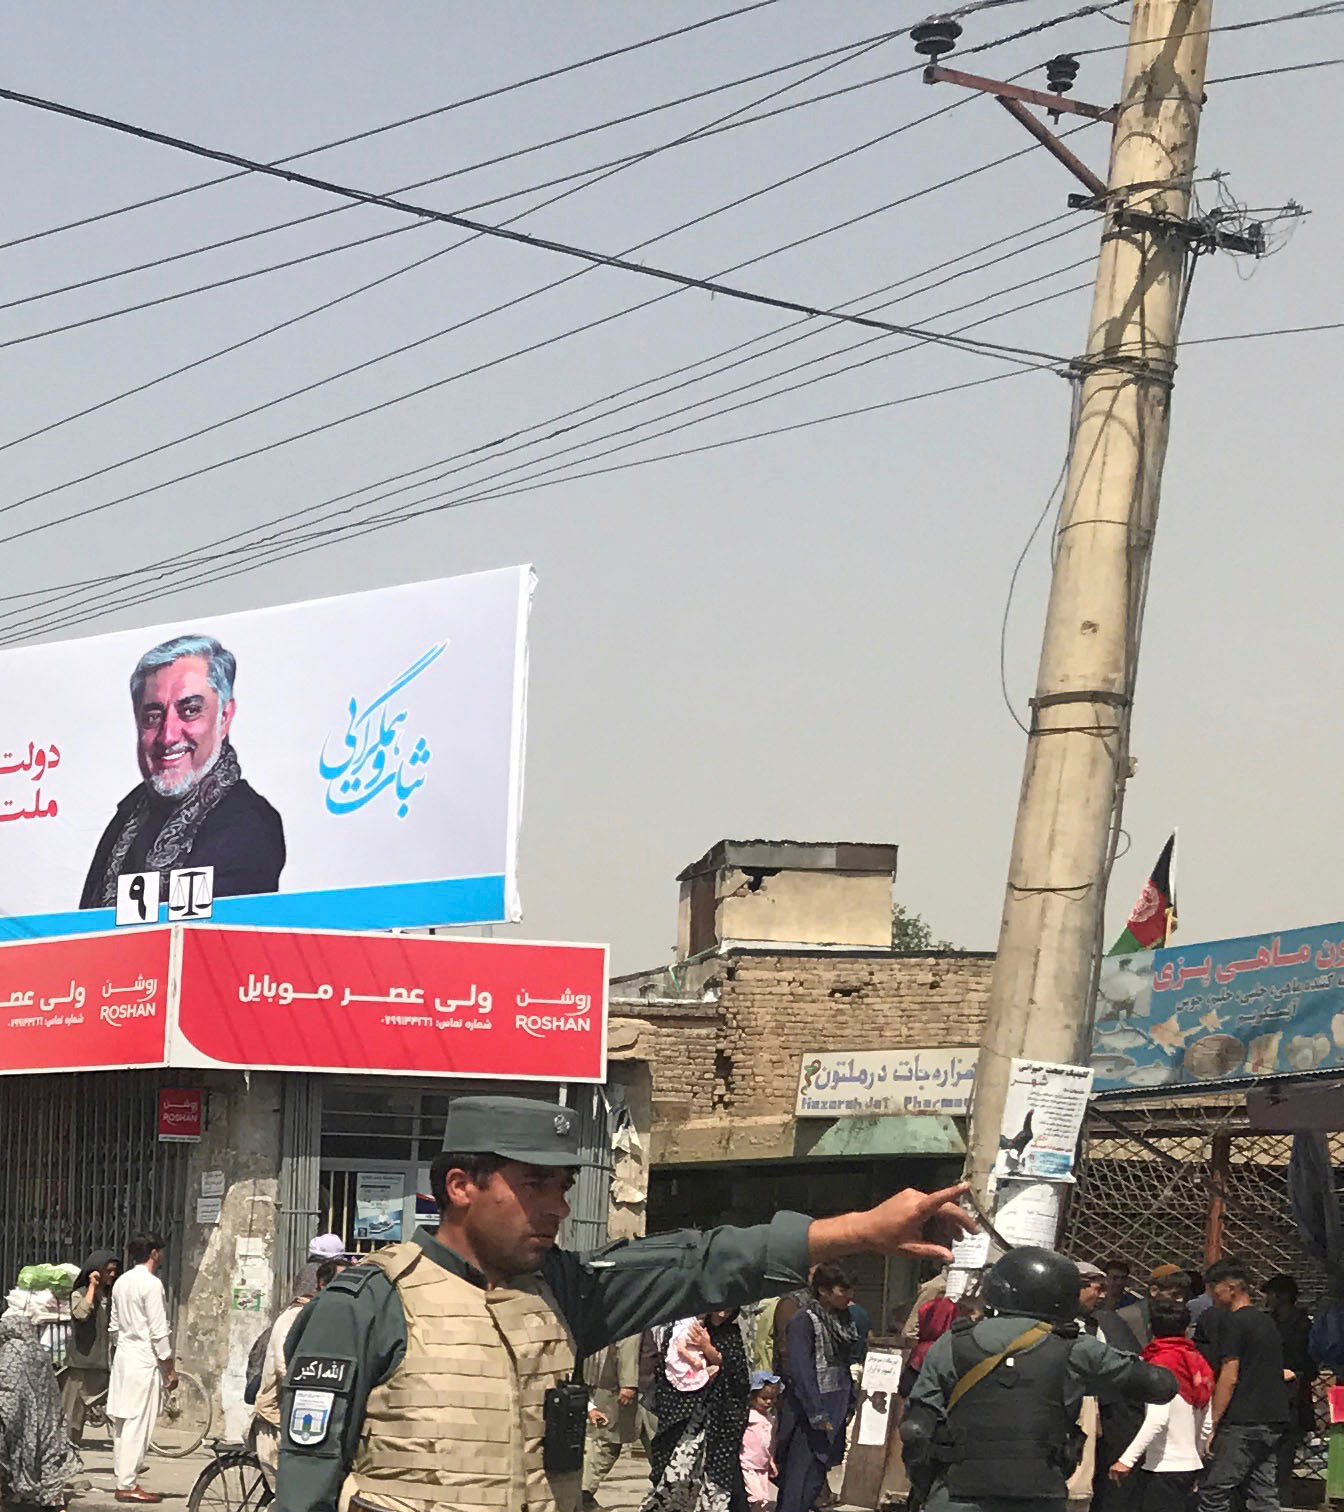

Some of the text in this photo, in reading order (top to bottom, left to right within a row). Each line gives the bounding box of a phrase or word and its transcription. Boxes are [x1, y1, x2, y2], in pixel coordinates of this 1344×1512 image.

[1152, 954, 1212, 993] پزی
[1214, 936, 1311, 985] ماهی
[39, 979, 86, 1011] ولی
[102, 973, 158, 1003] روشن
[238, 973, 592, 1017] روشن ولی عصر موبایل
[100, 1002, 156, 1027] ROSHAN
[515, 1014, 592, 1038] ROSHAN
[892, 1053, 931, 1091] جات
[321, 1360, 345, 1382] الله
